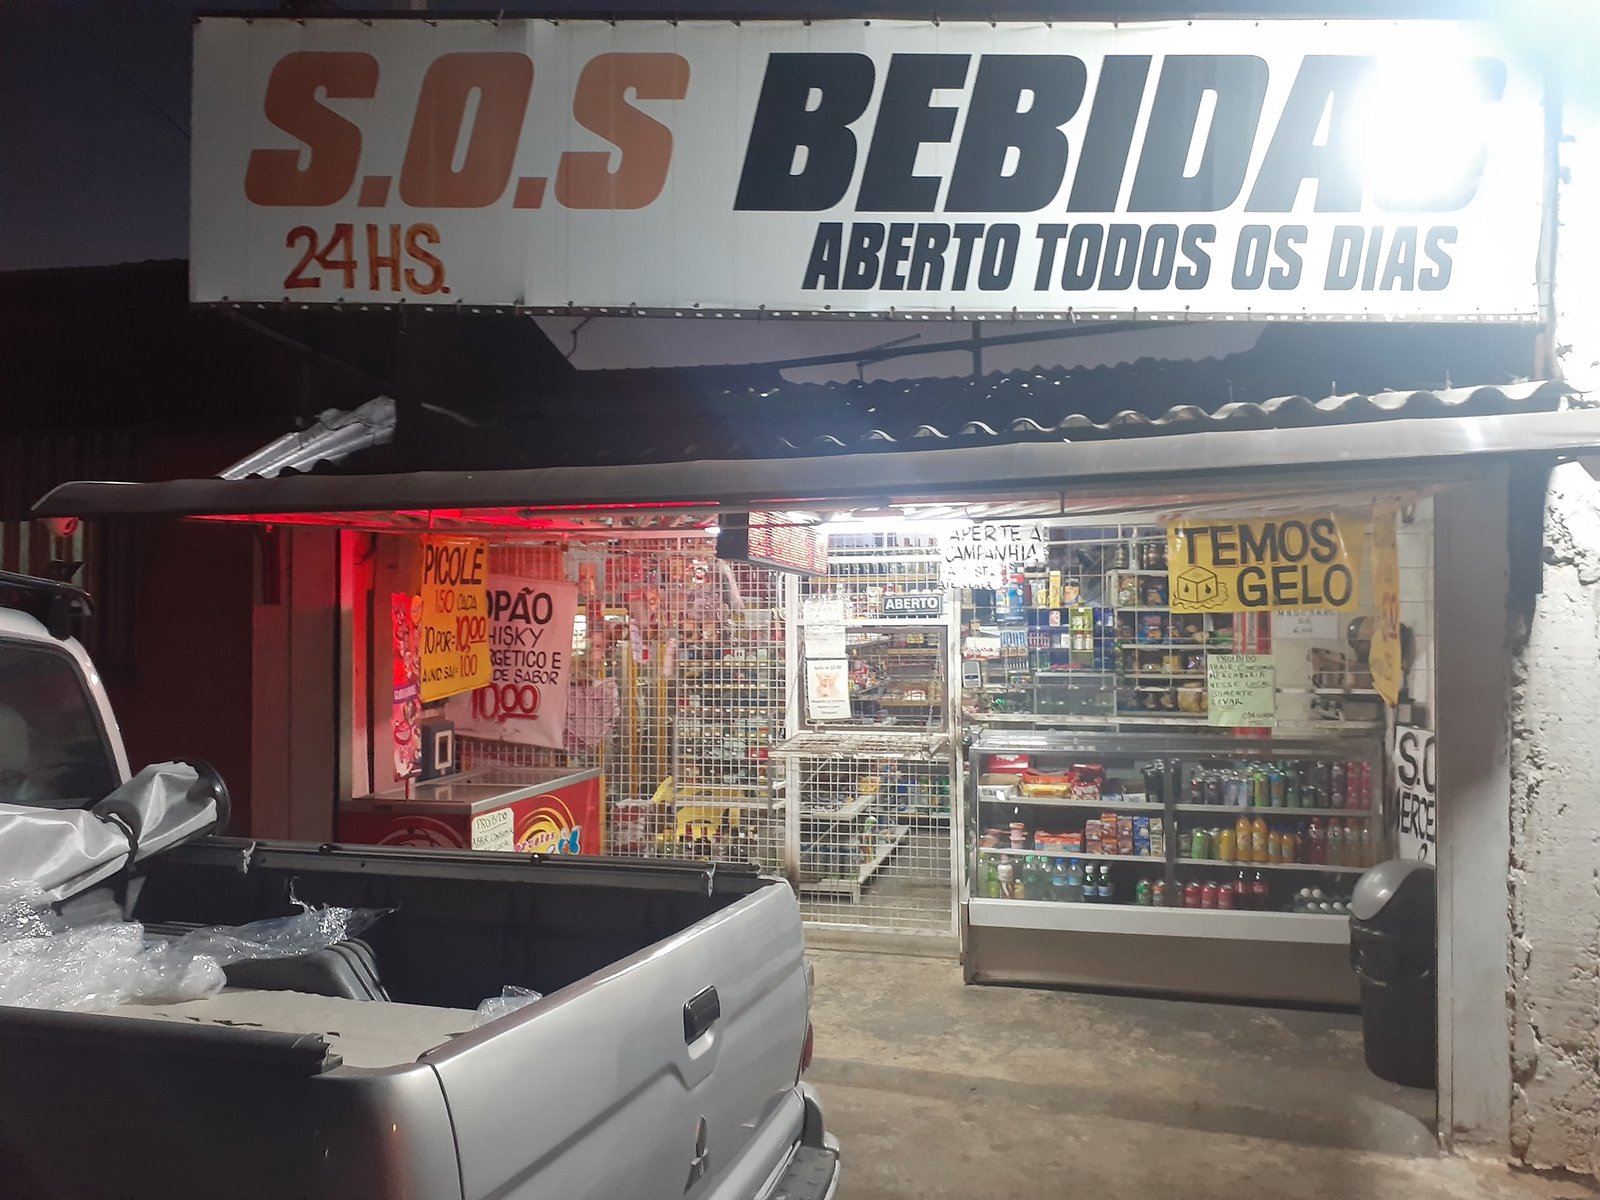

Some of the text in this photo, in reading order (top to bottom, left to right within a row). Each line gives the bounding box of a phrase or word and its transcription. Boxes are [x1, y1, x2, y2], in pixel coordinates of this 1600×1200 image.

[244, 51, 690, 210] S.O.S
[802, 222, 1459, 292] ABERTO TODOS OS DIAS
[423, 543, 485, 587] PICOLÉ
[1174, 518, 1338, 568] TEMOS
[885, 597, 938, 610] ABERTO
[1236, 563, 1353, 607] GELO
[493, 669, 559, 685] DE SABOR
[551, 652, 561, 670] E
